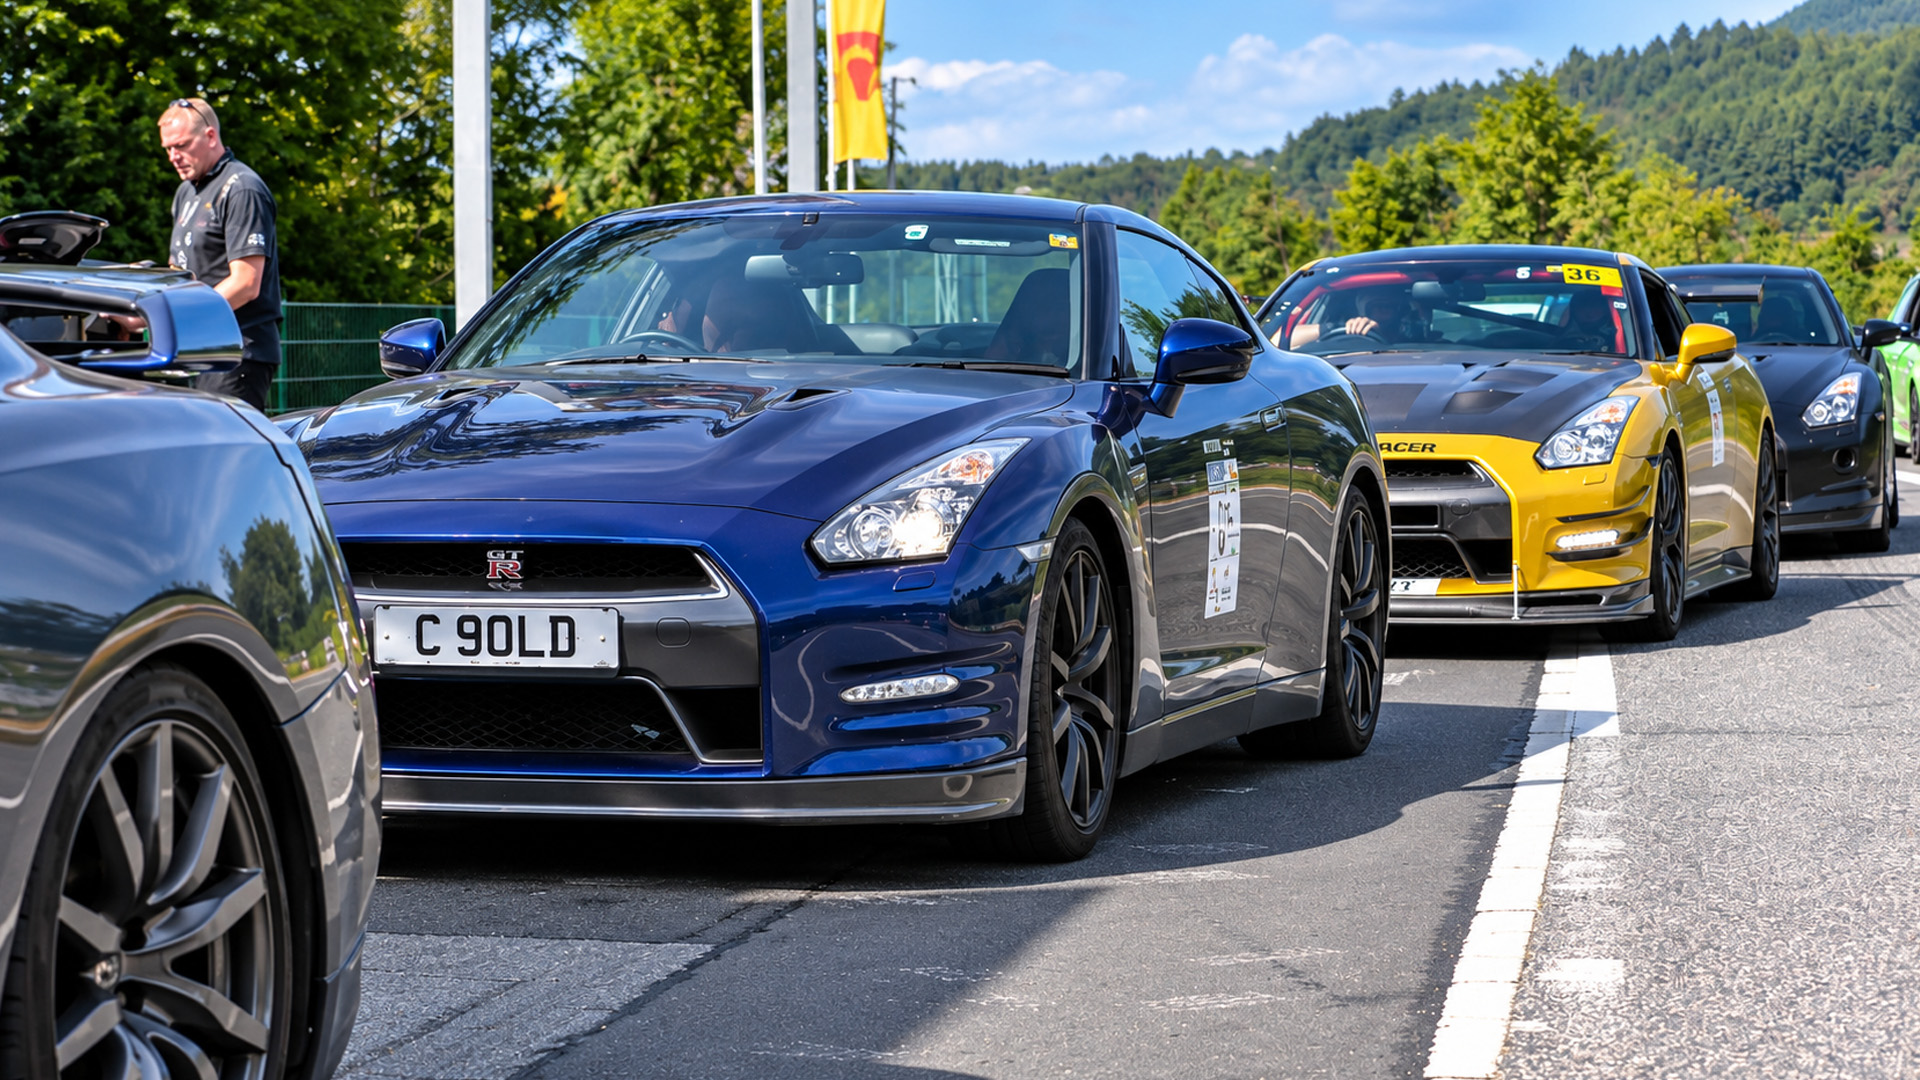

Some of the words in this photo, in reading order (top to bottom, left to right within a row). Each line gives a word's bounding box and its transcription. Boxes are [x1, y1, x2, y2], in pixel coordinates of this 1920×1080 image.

[1567, 268, 1601, 281] 36
[486, 550, 524, 560] GT
[486, 559, 524, 579] R
[416, 614, 441, 656] C
